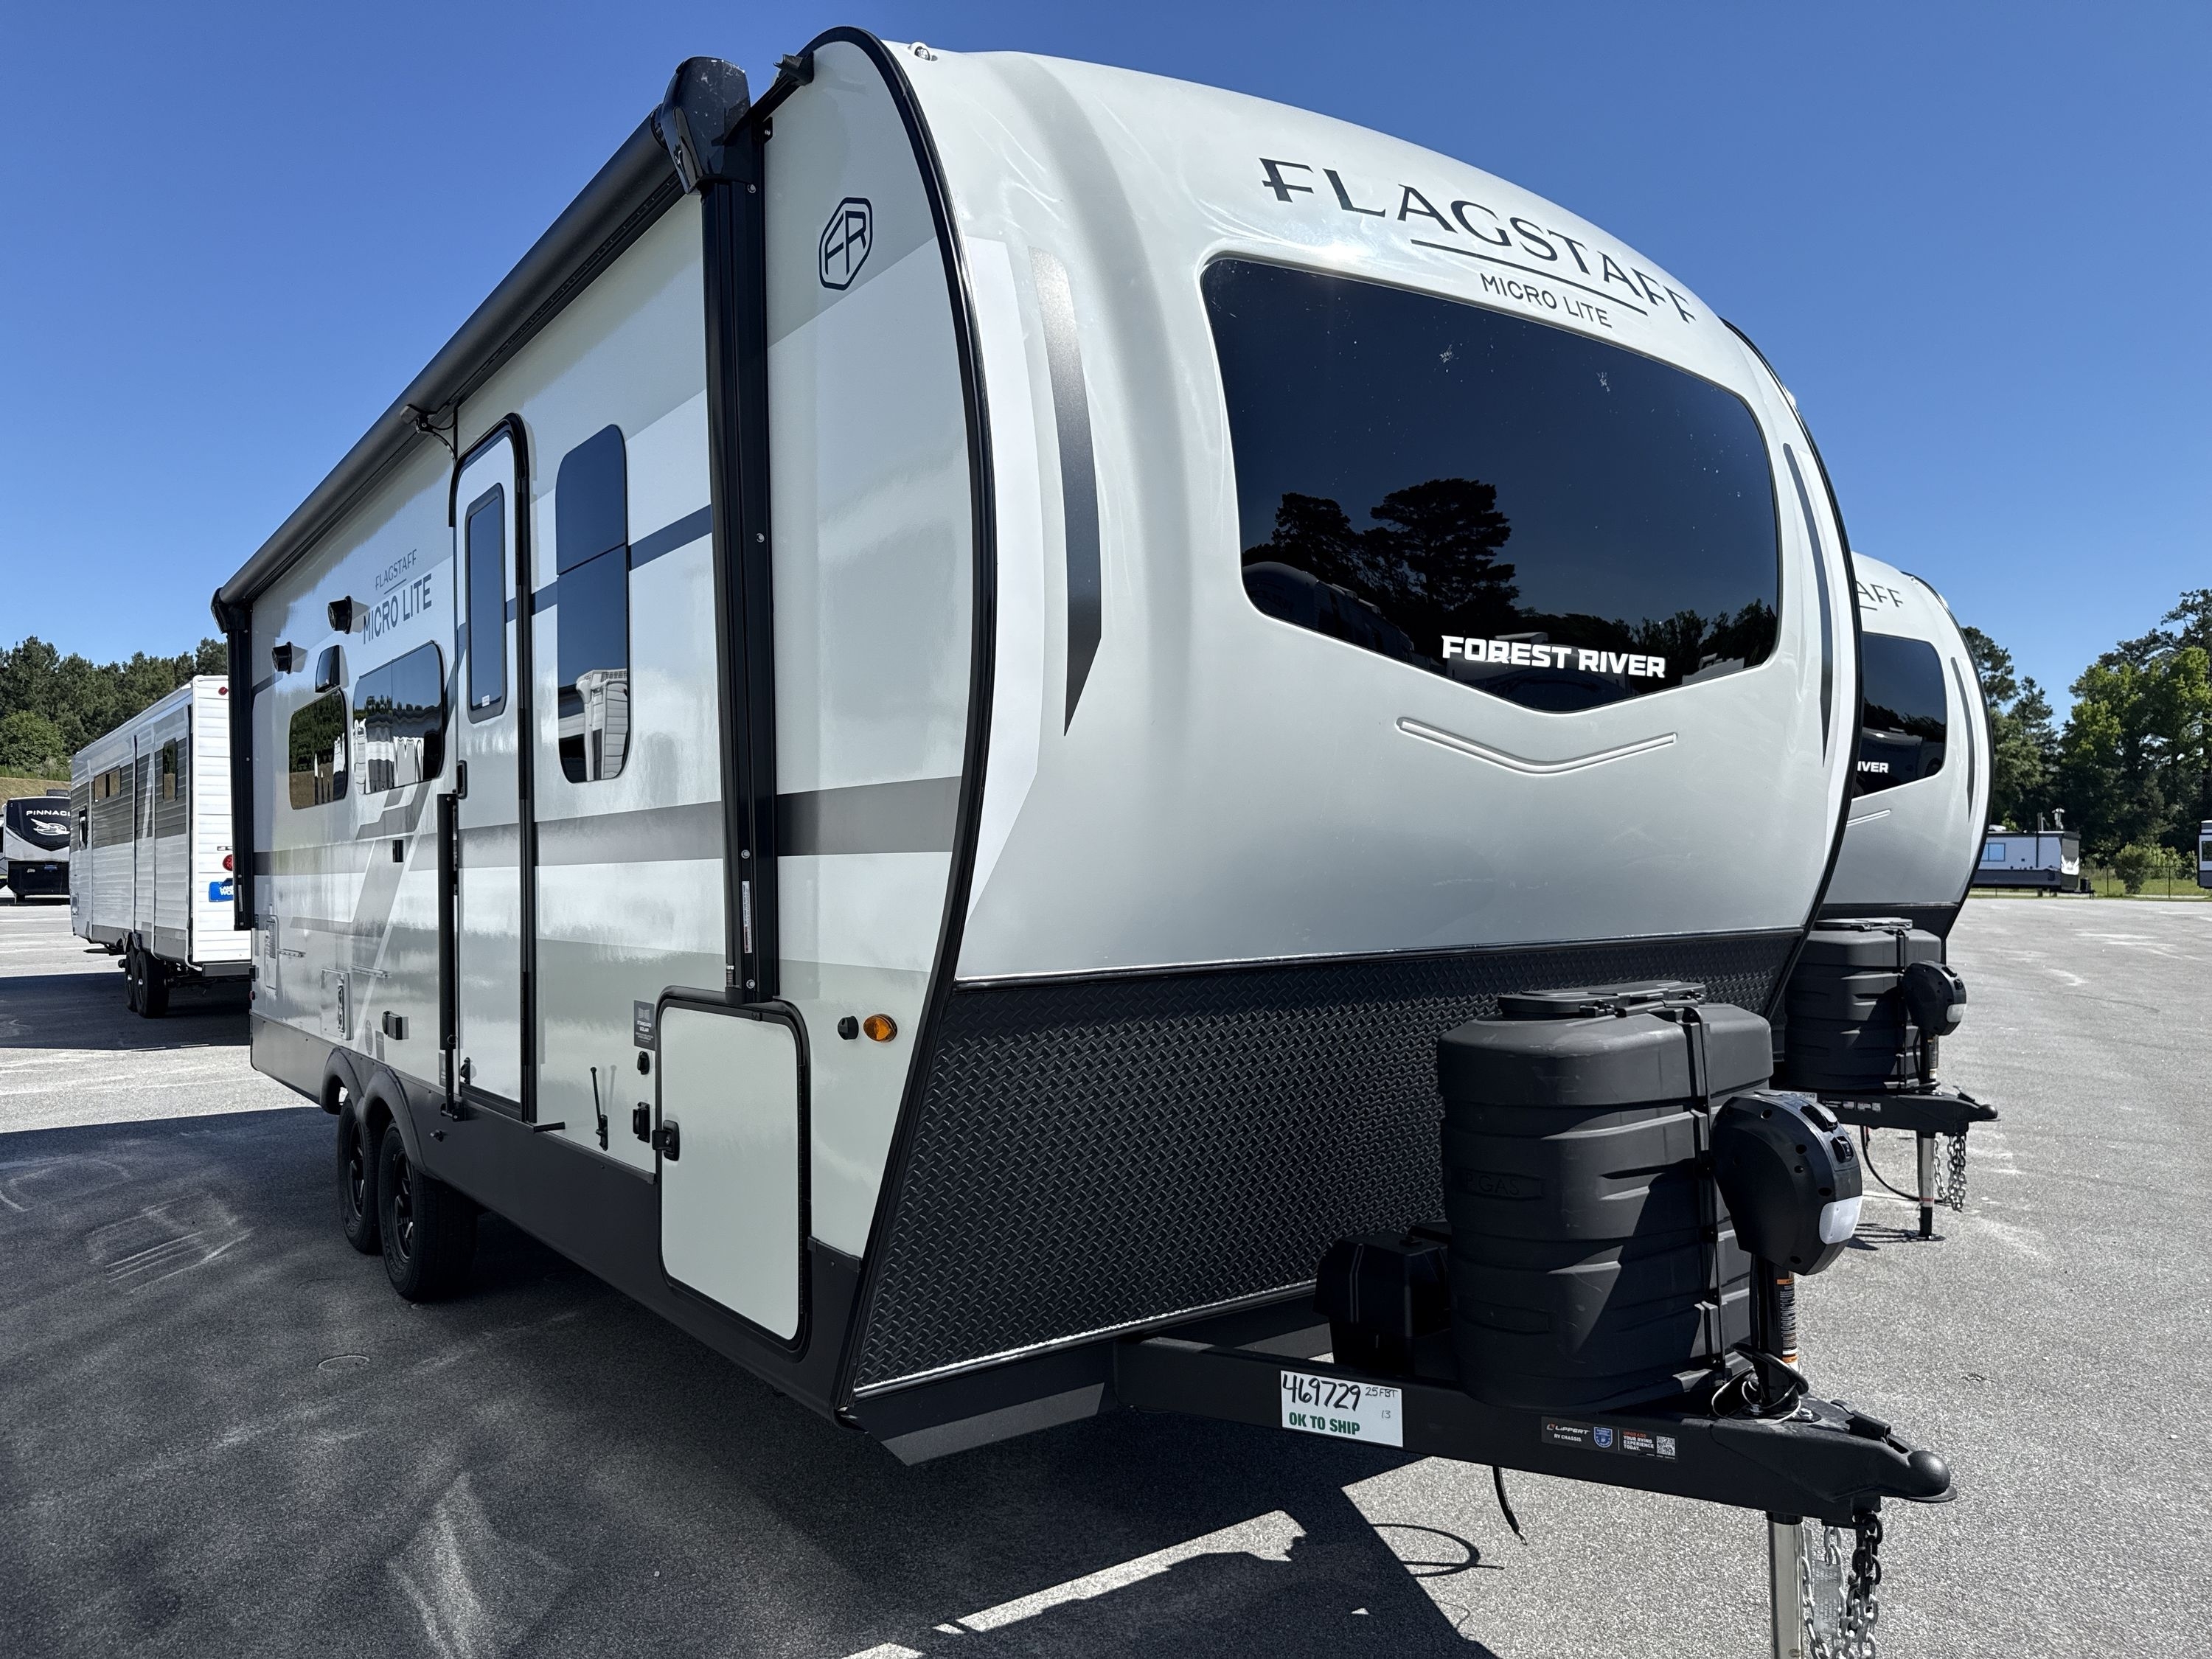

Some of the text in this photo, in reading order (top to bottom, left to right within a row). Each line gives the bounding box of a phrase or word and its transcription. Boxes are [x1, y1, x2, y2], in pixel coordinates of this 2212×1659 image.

[1258, 156, 1697, 324] FLAGSTAFF
[1479, 272, 1613, 328] MICRO LITE
[375, 549, 417, 591] FLAGSTAFF
[364, 573, 432, 645] MICRO LITE
[1441, 635, 1666, 678] FOREST RIVER
[1857, 760, 1889, 773] IVER
[1282, 1374, 1361, 1412] 469729
[1289, 1411, 1360, 1436] OK TO SHIP
[1381, 1410, 1391, 1419] 13
[1561, 1434, 1582, 1442] CHASSIS
[1624, 1440, 1655, 1450] EXPERIENCE
